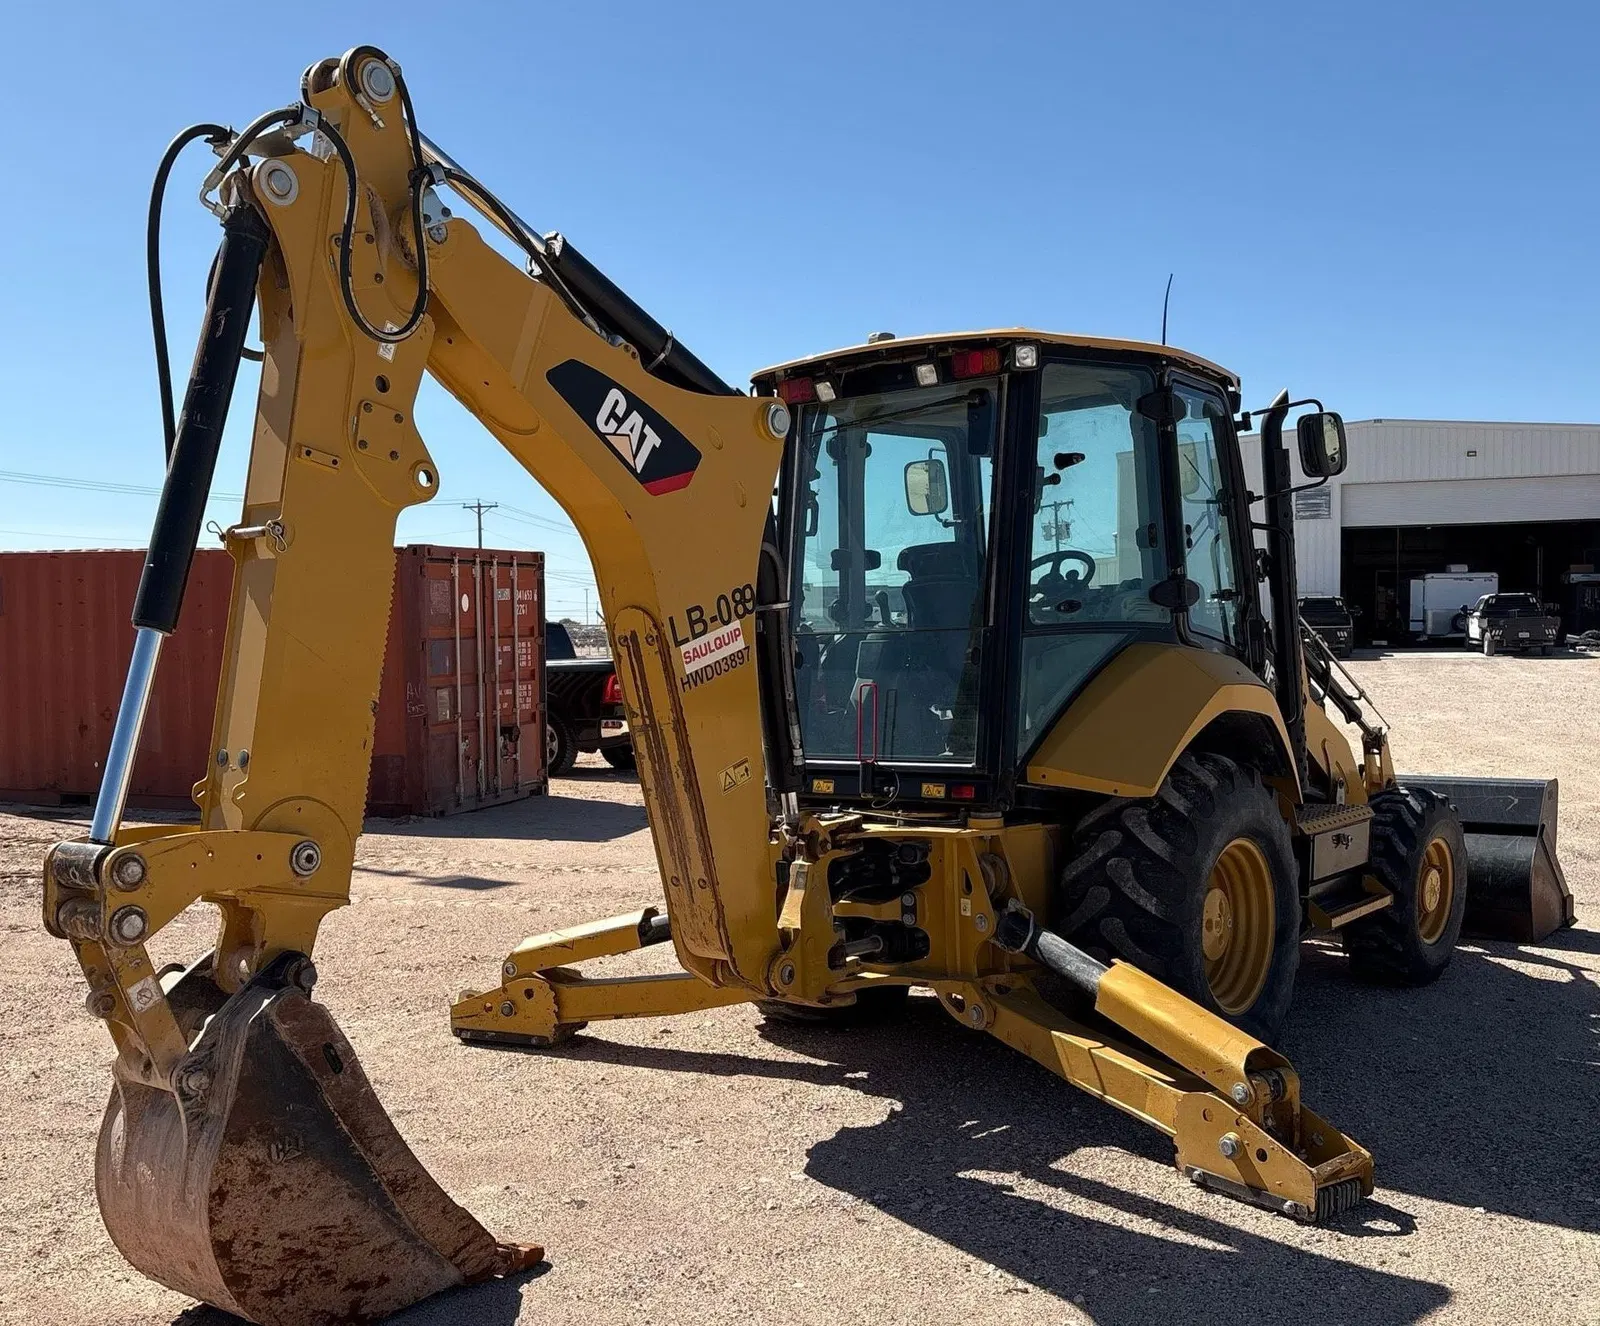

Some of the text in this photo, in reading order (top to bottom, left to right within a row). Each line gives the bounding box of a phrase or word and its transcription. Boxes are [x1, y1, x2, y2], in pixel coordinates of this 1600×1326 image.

[596, 388, 662, 474] CAT
[668, 583, 757, 648] LB-089
[680, 646, 750, 693] HWD03897
[683, 627, 741, 665] SAULQUIP
